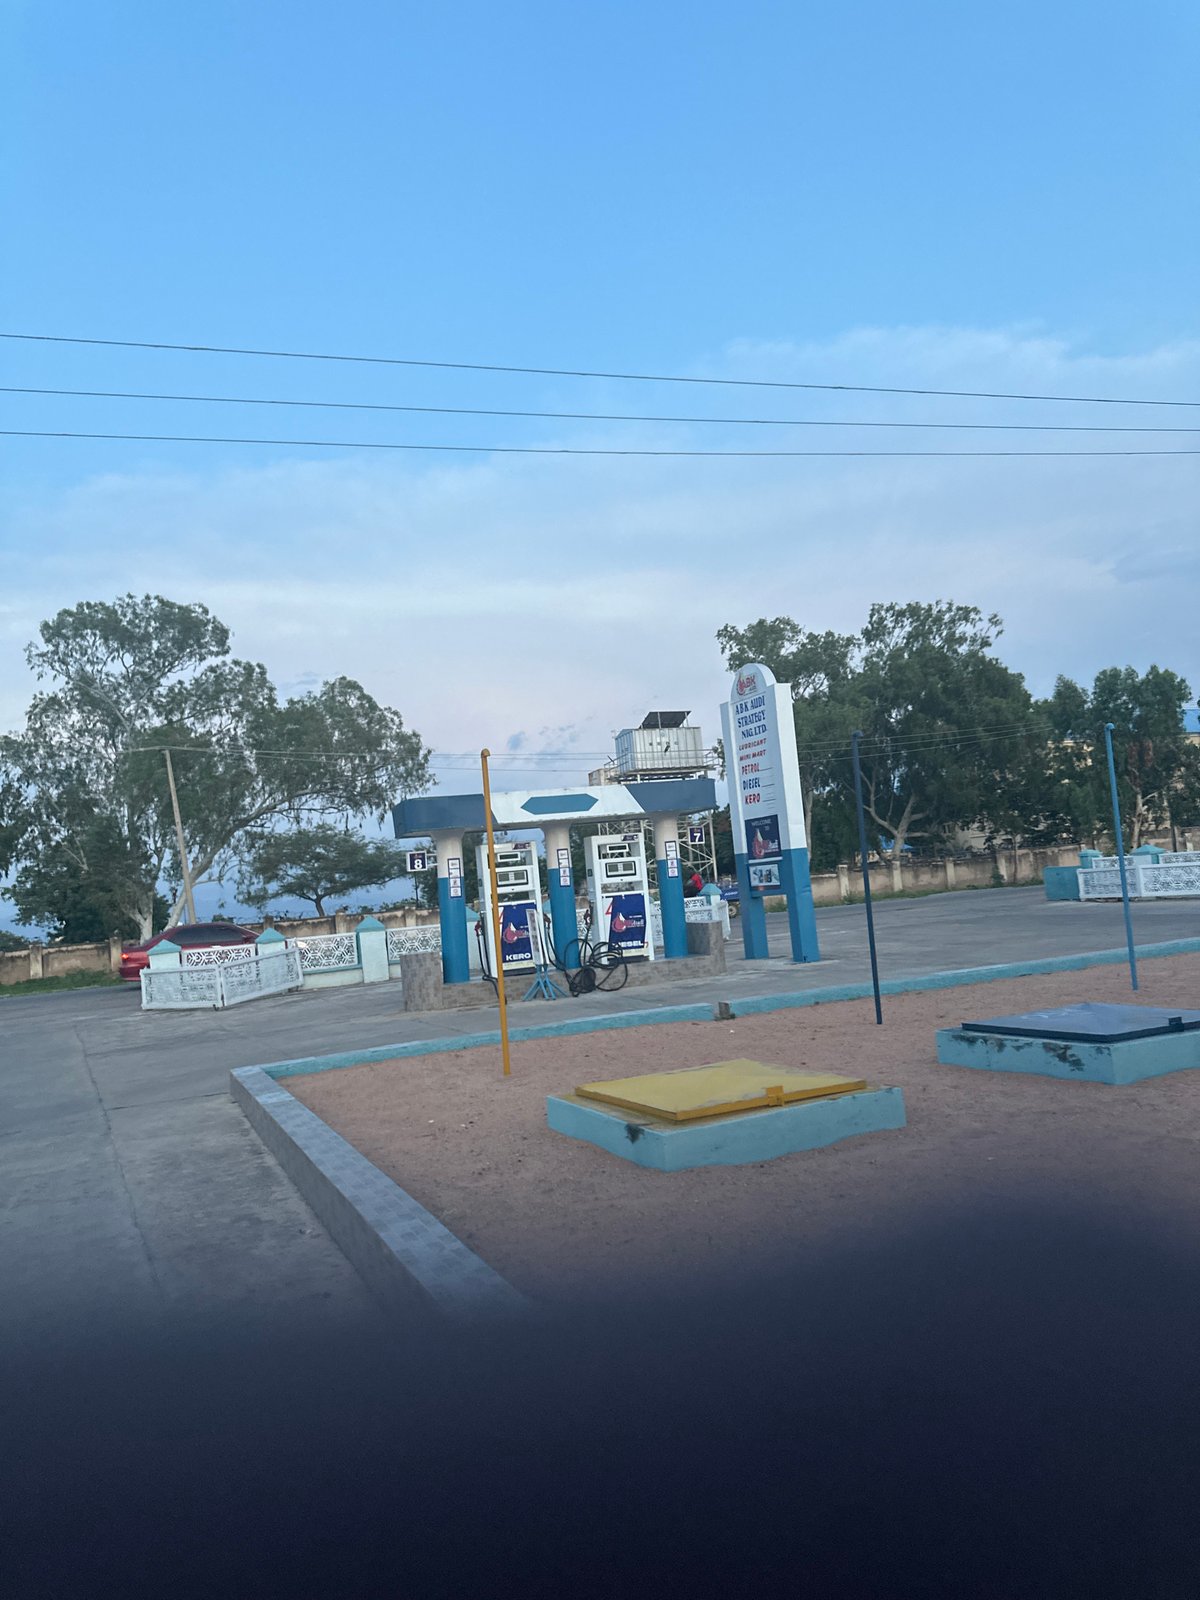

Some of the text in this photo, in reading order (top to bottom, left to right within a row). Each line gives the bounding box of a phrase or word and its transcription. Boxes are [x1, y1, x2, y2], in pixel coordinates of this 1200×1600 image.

[736, 695, 765, 715] ABK AUDI
[737, 710, 766, 728] STRATEGY
[739, 738, 767, 751] LUBRICANT
[752, 749, 767, 759] MART
[742, 762, 760, 775] PETROL
[743, 777, 761, 790] DIESEL
[745, 793, 761, 805] KERO
[693, 832, 701, 843] 7
[414, 859, 423, 870] 8
[505, 952, 531, 961] KERO
